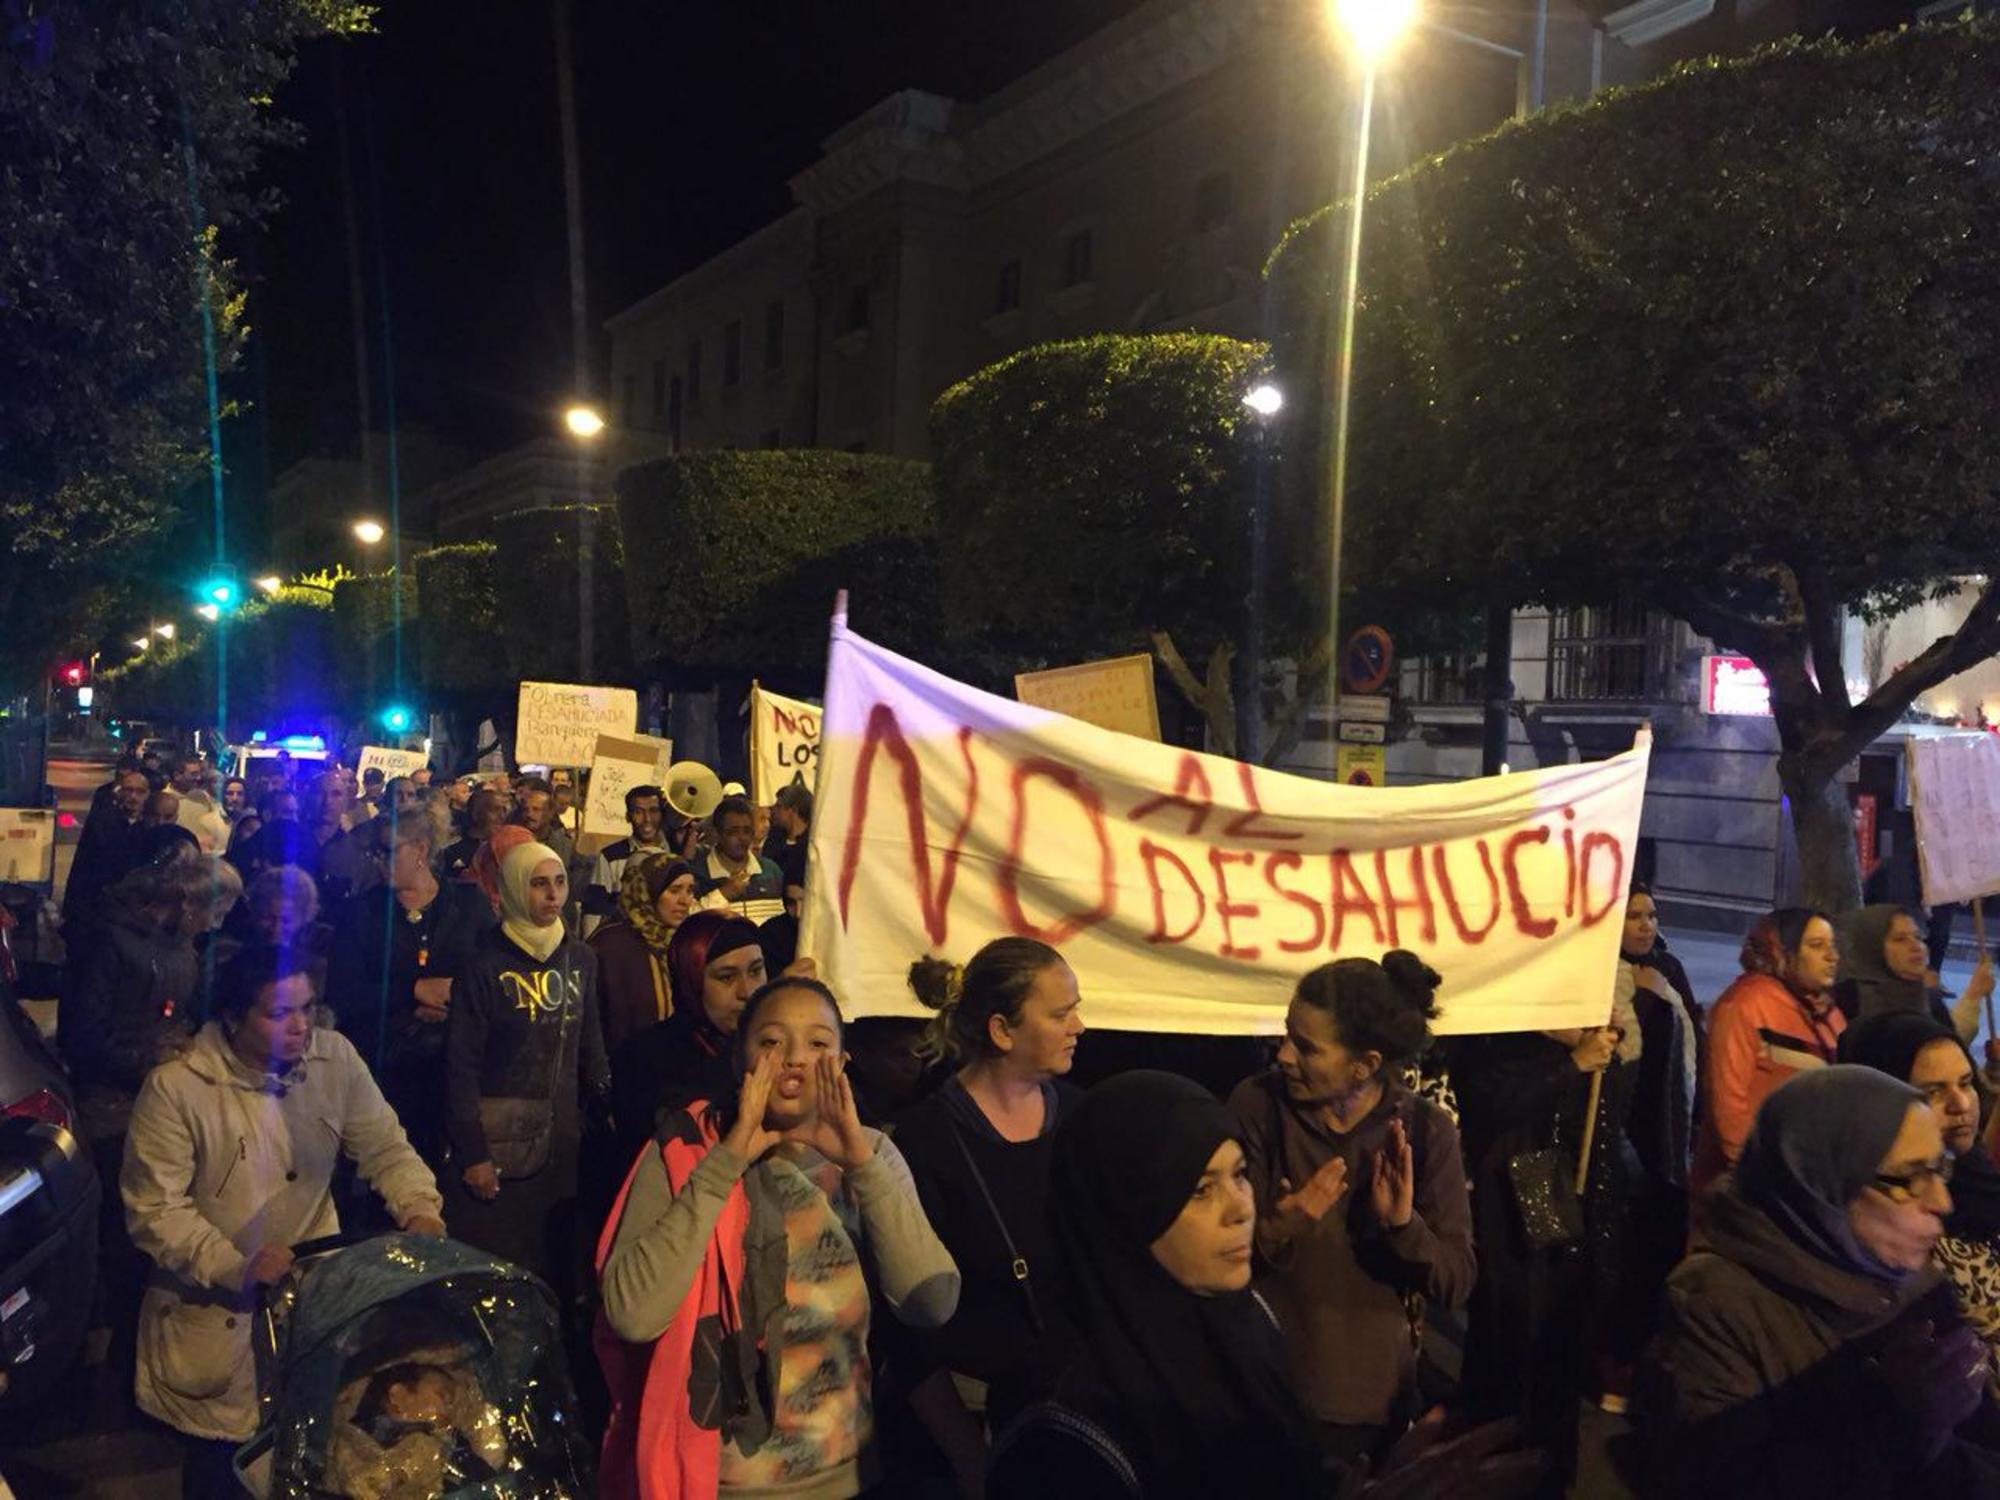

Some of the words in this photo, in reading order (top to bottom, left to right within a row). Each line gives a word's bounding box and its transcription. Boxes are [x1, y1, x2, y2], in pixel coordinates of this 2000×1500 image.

[773, 706, 817, 739] NO
[838, 702, 1114, 946] NO
[1127, 752, 1305, 839] AL
